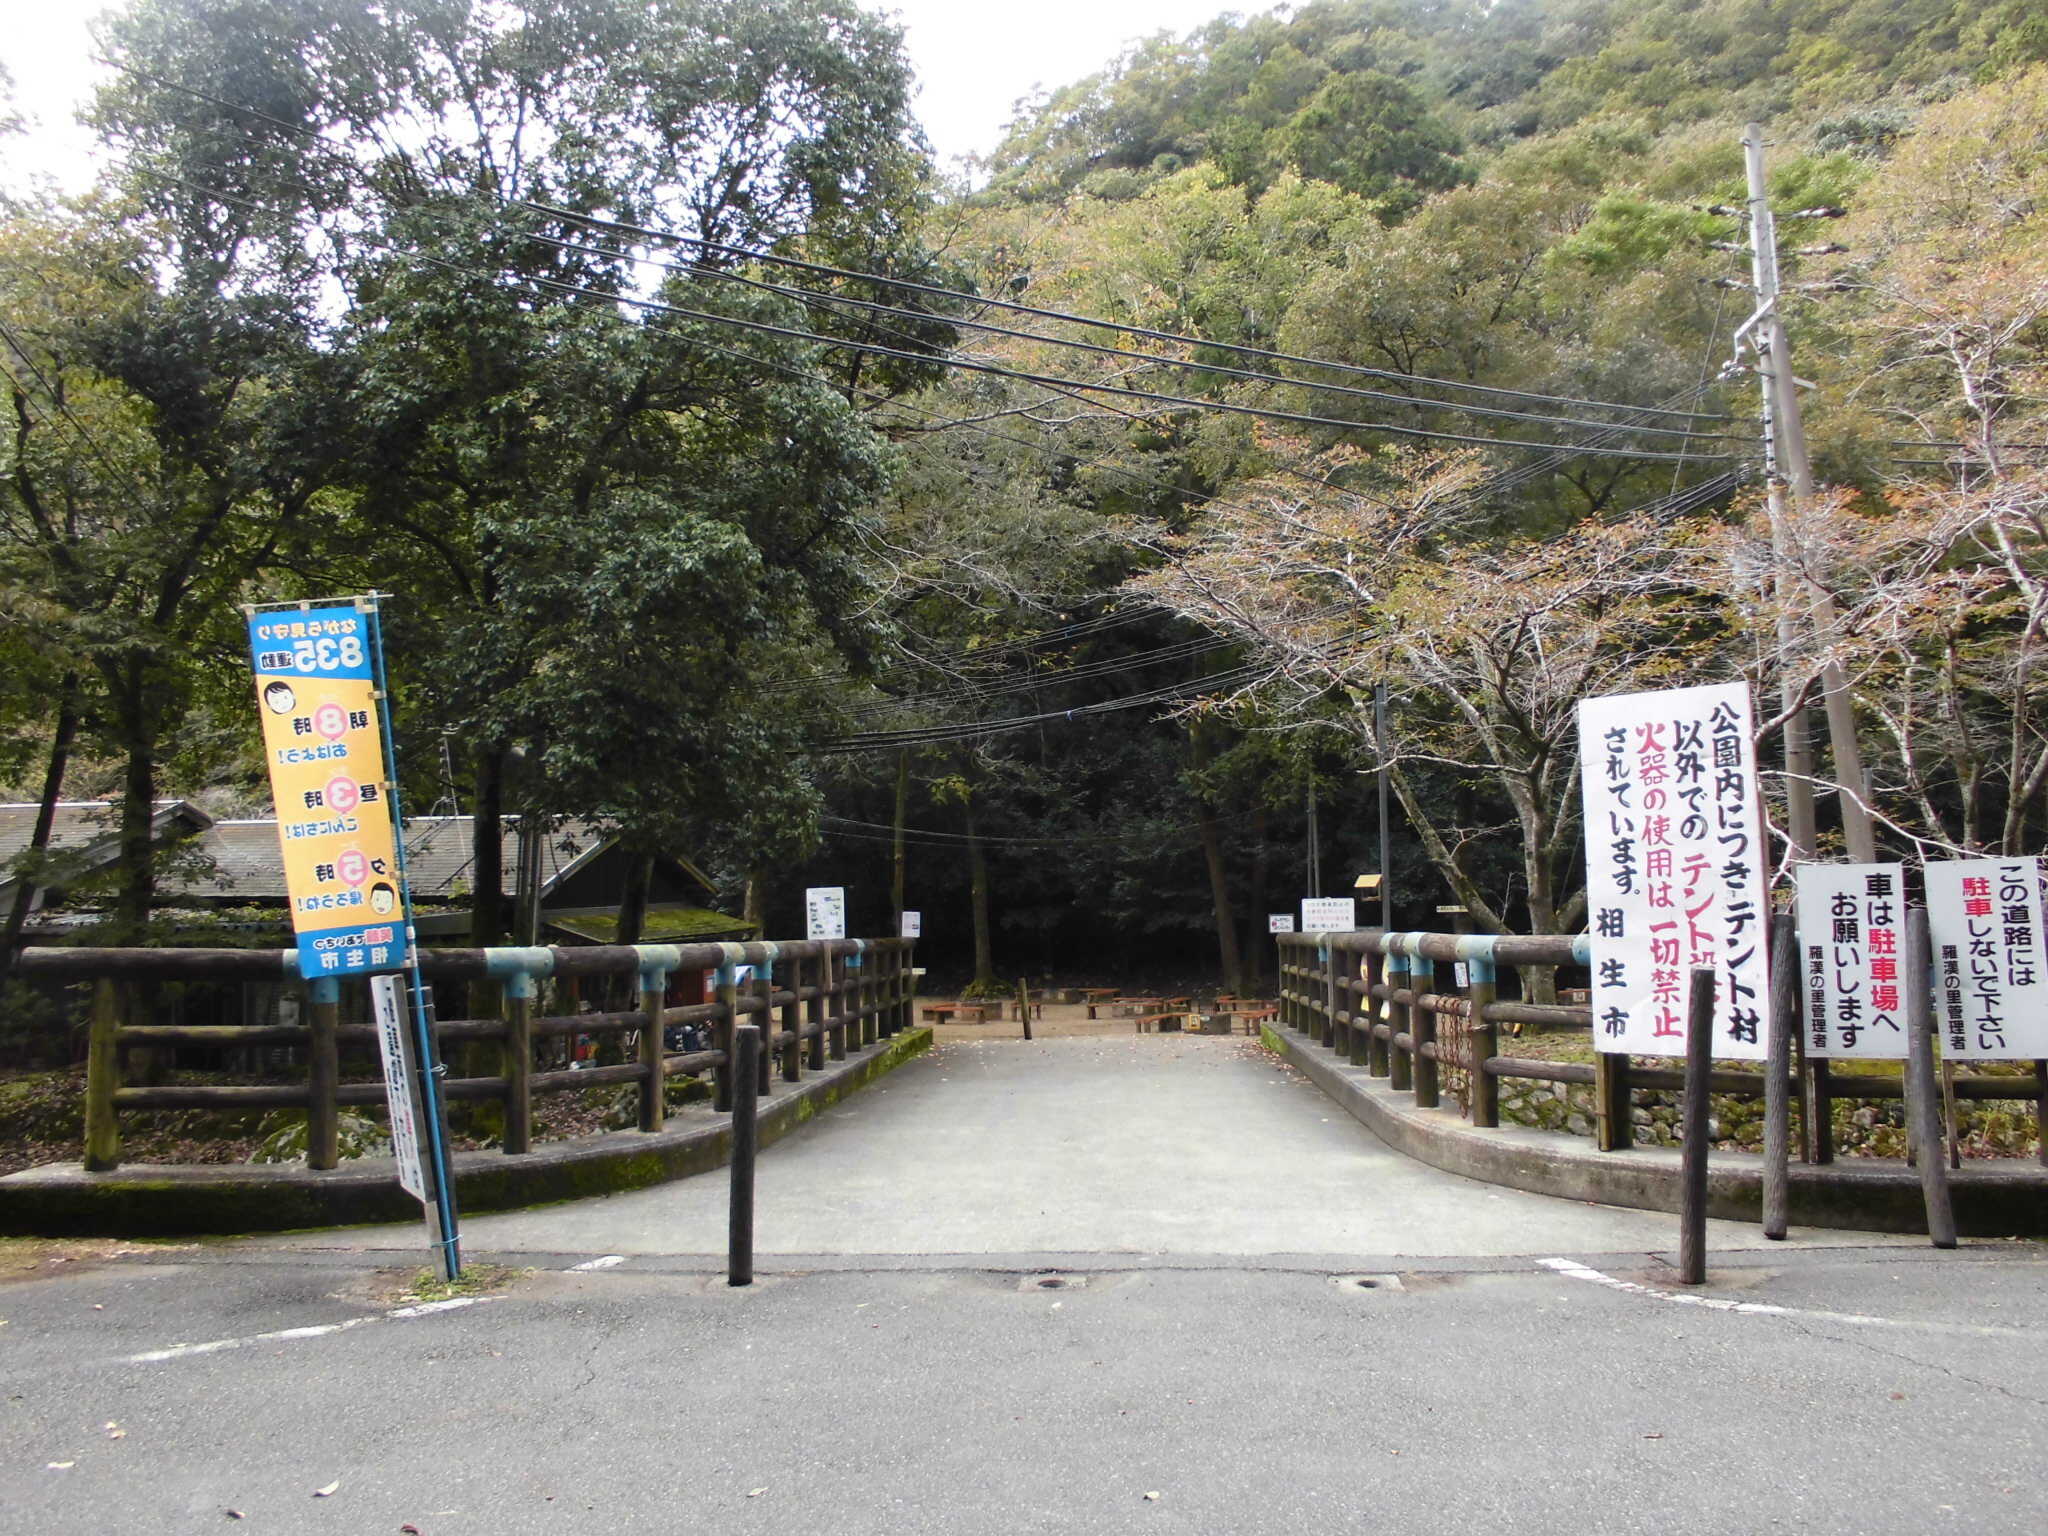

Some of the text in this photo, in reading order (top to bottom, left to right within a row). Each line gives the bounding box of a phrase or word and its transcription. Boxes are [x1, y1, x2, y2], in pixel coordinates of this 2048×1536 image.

[1603, 726, 1641, 896] されています。
[1635, 721, 1685, 1038] 火器の使用は一切禁止
[1672, 720, 1723, 1020] 以外でのテント
[1708, 701, 1761, 1045] 公園内につきテント村
[1596, 907, 1630, 1039] 相生市
[1808, 945, 1827, 1048] 羅漢の里管理者
[1831, 892, 1865, 1049] お願いします
[1865, 872, 1900, 1032] 車は駐車場へ
[1942, 944, 1966, 1050] 羅漢の里管理者
[1961, 877, 2006, 1050] 駐車しないで下さい
[2000, 865, 2036, 986] この道路には
